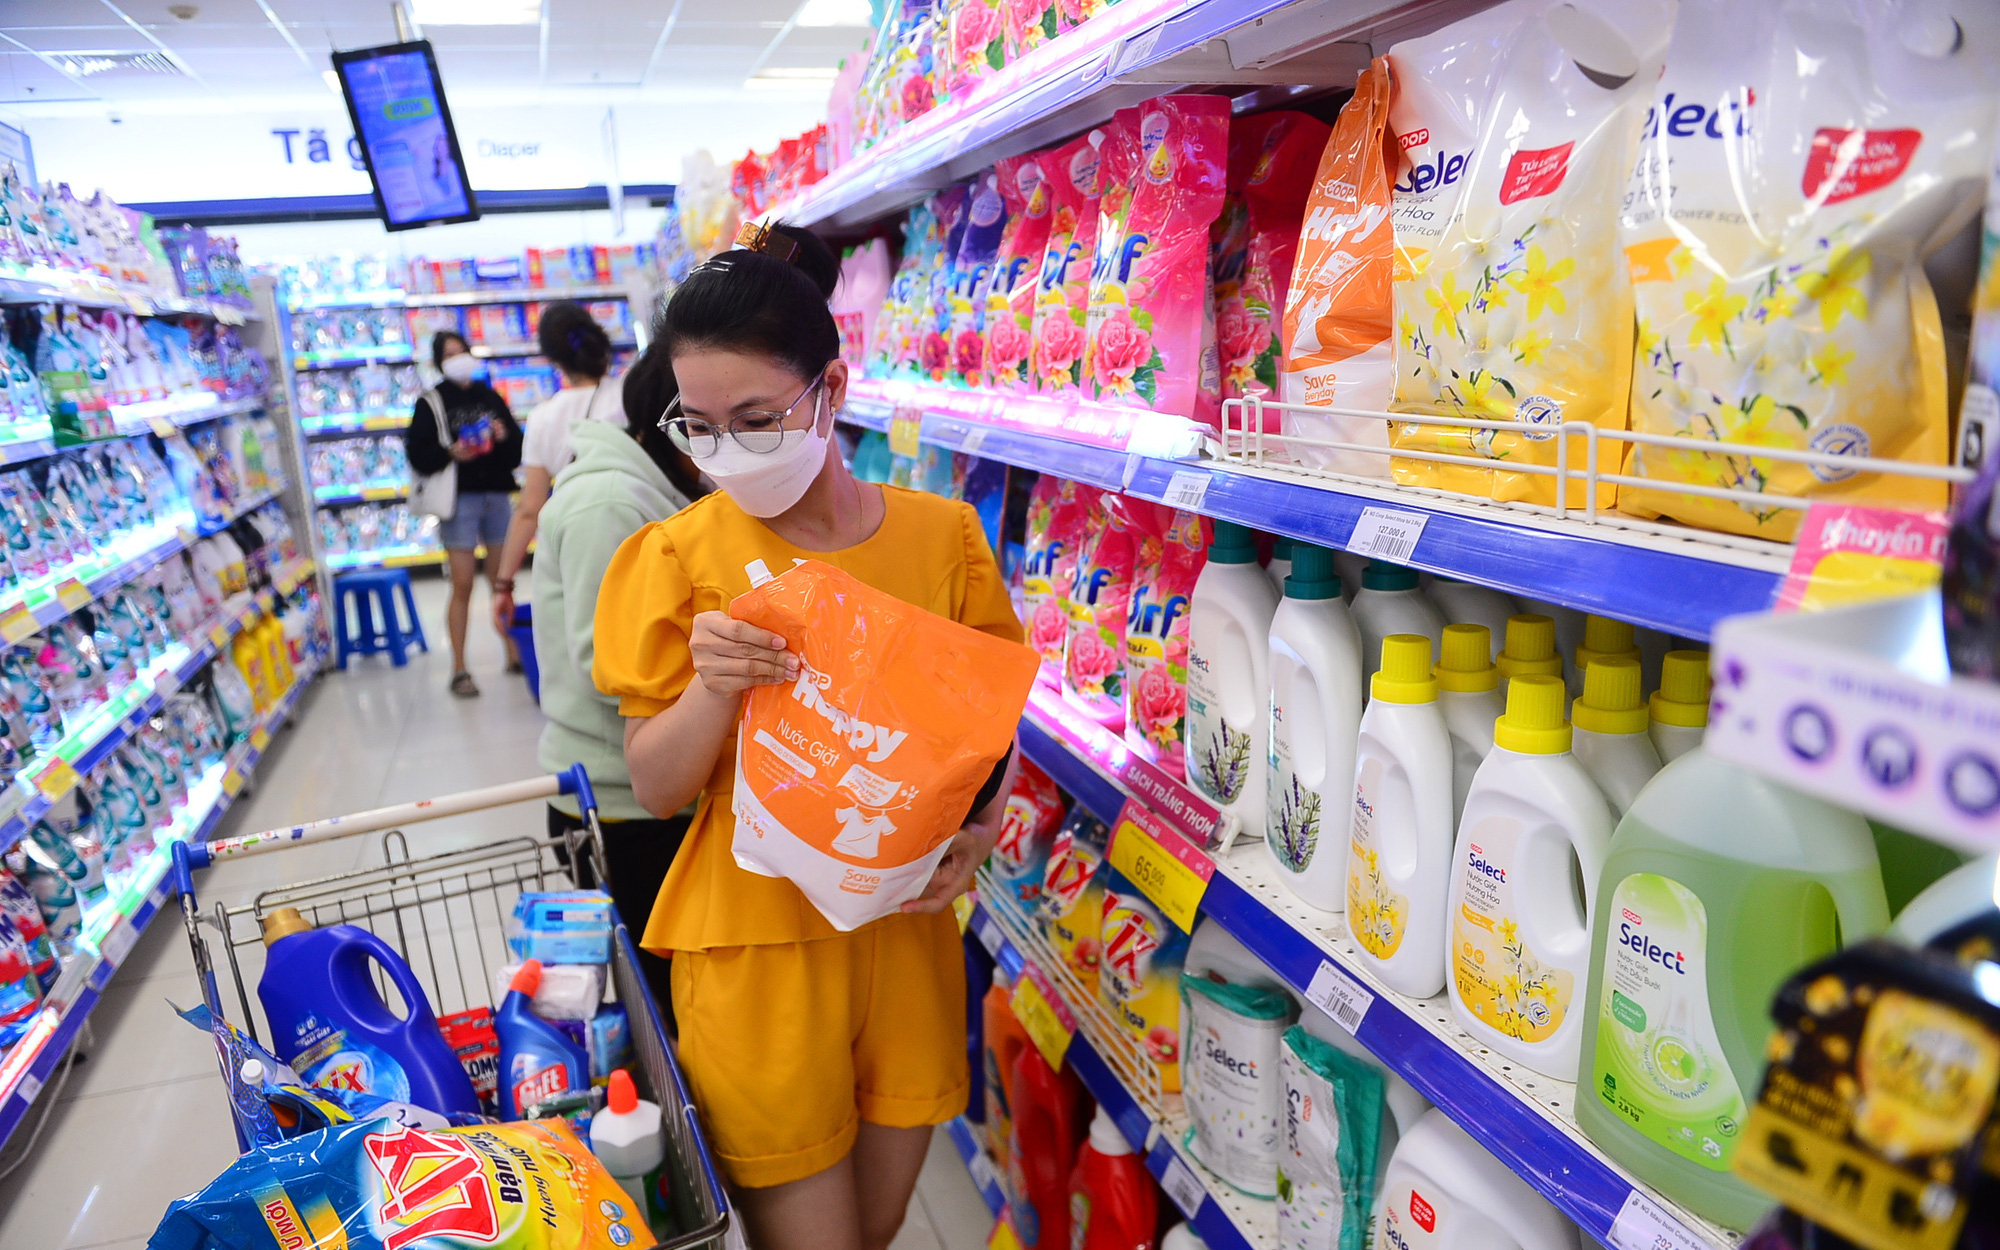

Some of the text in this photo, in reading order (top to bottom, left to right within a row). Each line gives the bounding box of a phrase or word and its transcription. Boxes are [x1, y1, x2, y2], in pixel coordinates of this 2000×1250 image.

[272, 129, 331, 164] Tã
[478, 139, 542, 159] Diaper
[1401, 130, 1429, 150] OOP
[1401, 205, 1436, 221] Hoa
[1303, 373, 1337, 391] Save
[1304, 388, 1336, 402] Everyday
[1378, 525, 1400, 537] 127.000
[776, 716, 840, 769] Nước Giặt
[1127, 765, 1215, 838] SẠCH TRẮNG THƠM
[752, 822, 765, 839] kg
[845, 868, 882, 885] Save
[1466, 869, 1498, 893] Nước Giặt
[1468, 852, 1506, 884] Select
[840, 879, 879, 891] Everyday
[1465, 879, 1501, 905] Hương Hoa
[1616, 949, 1650, 975] Nước Giặt
[1619, 922, 1686, 976] Select
[1616, 959, 1630, 974] Tinh
[1628, 967, 1644, 982] Dầu
[1643, 976, 1662, 992] Bưởi
[1206, 1038, 1259, 1080] Select
[518, 1068, 562, 1108] Gift
[1285, 1082, 1302, 1158] Select
[1629, 1110, 1640, 1123] kg
[488, 1152, 524, 1204] Đậm
[532, 1174, 558, 1229] Hương
[264, 1198, 298, 1238] MỚI
[1674, 1230, 1691, 1245] Coop
